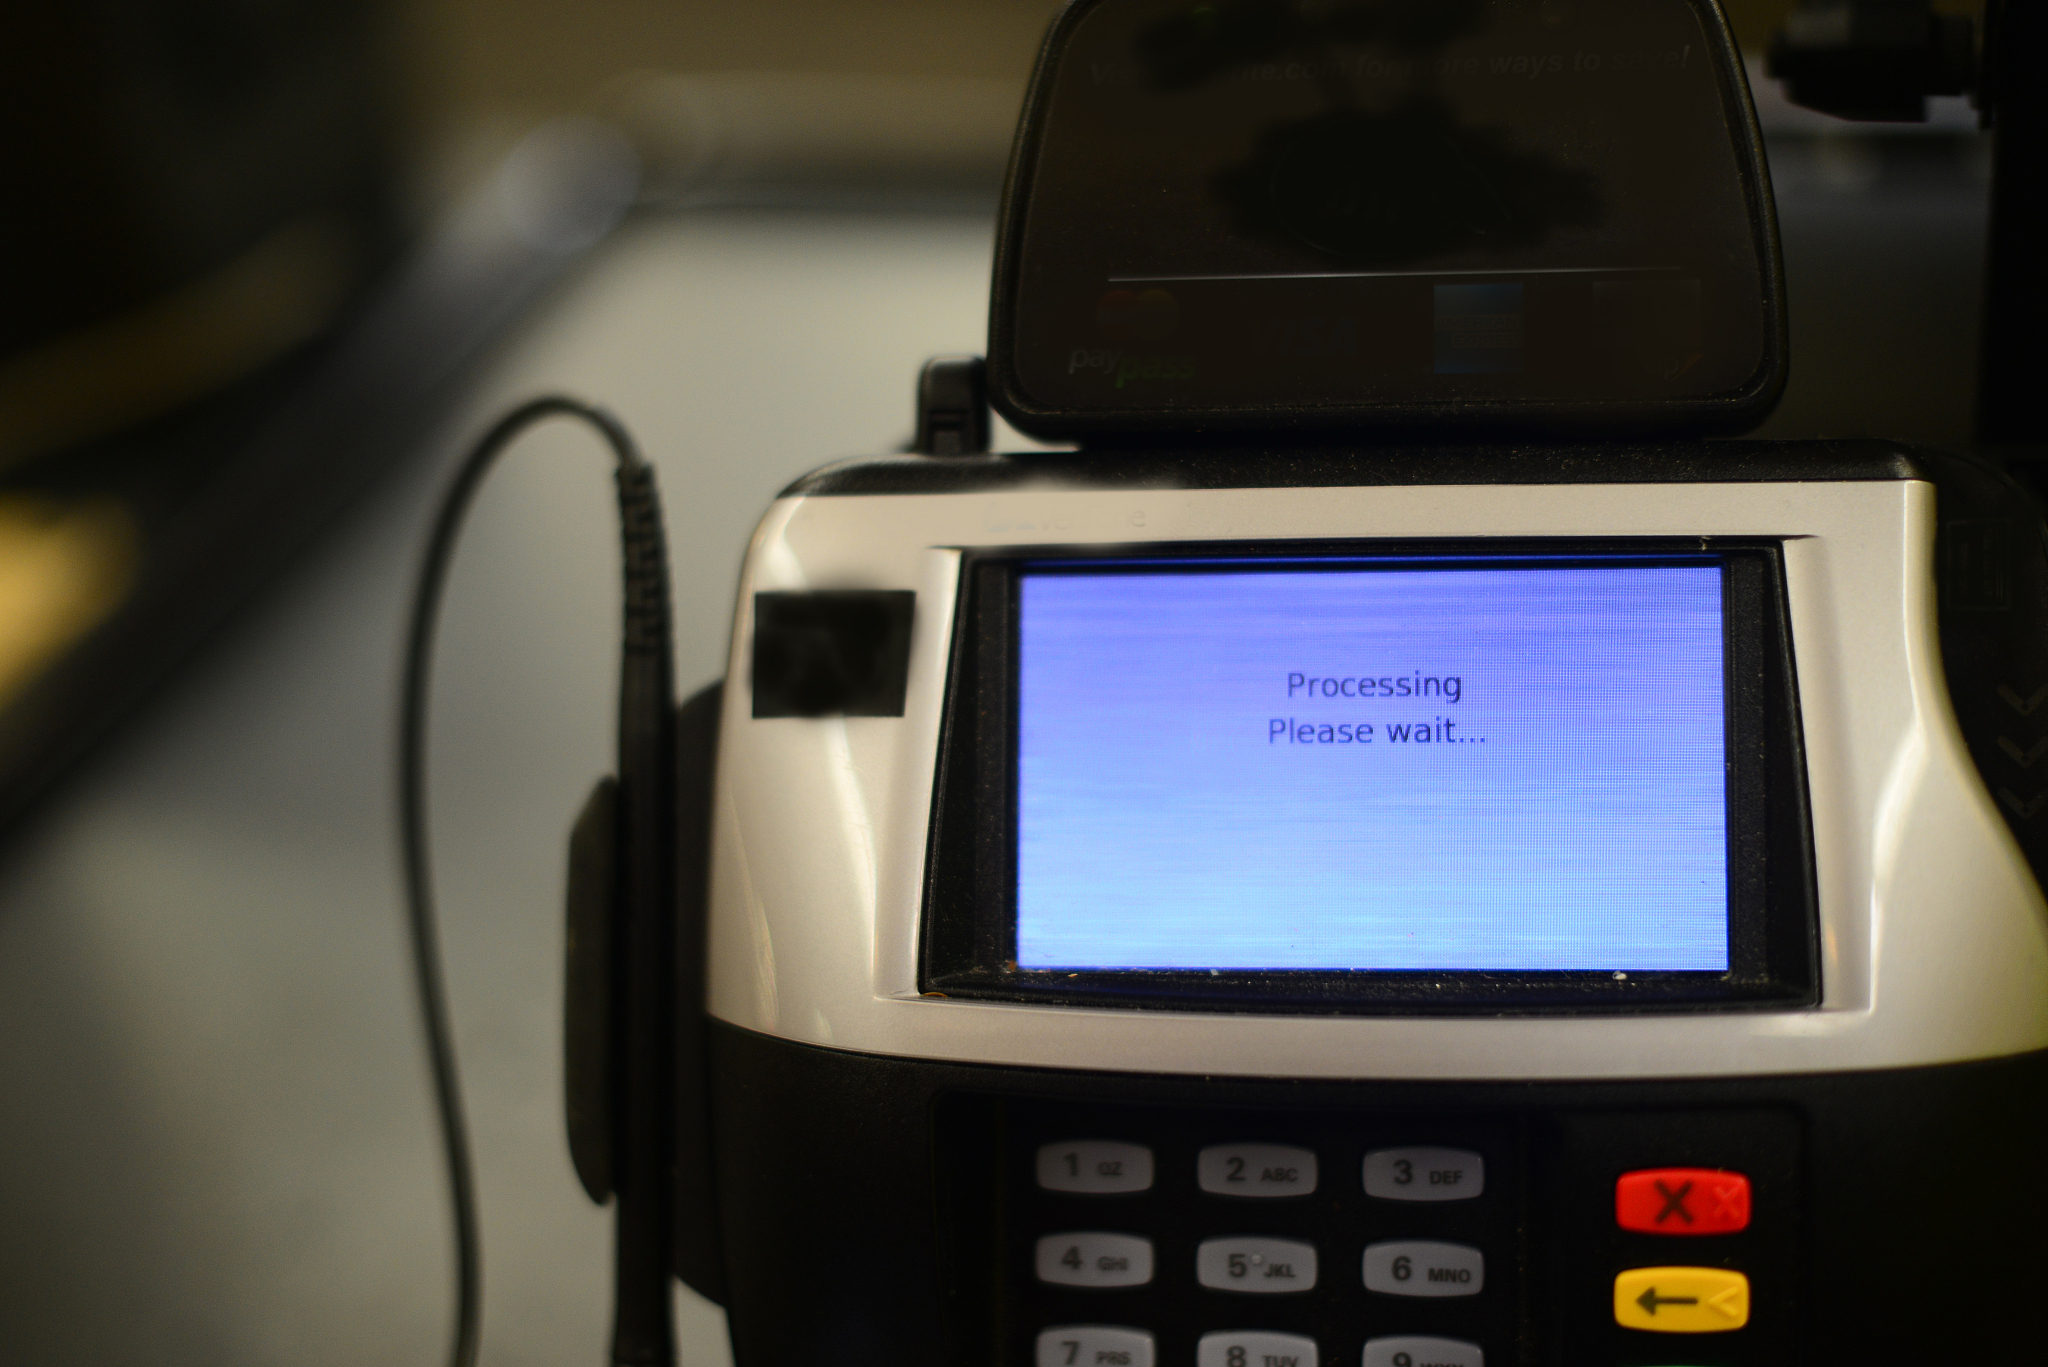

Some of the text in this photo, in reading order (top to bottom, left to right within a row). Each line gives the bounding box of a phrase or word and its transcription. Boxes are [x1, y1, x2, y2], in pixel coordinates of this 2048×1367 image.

[1356, 54, 1398, 79] for
[1488, 55, 1563, 81] ways
[1572, 49, 1602, 73] to
[1610, 44, 1691, 71] save!
[1287, 670, 1462, 704] Processing
[1268, 715, 1487, 745] Please wait...
[1063, 1152, 1080, 1178] 1
[1226, 1156, 1298, 1183] 2 ABC
[1393, 1159, 1464, 1185] 3 DEF
[1061, 1245, 1129, 1272] 4 GHI
[1228, 1252, 1297, 1279] 5 JKL
[1392, 1256, 1472, 1284] 6 MNO
[1060, 1340, 1131, 1366] 7 PRS
[1227, 1345, 1247, 1367] 8
[1392, 1351, 1413, 1367] 9
